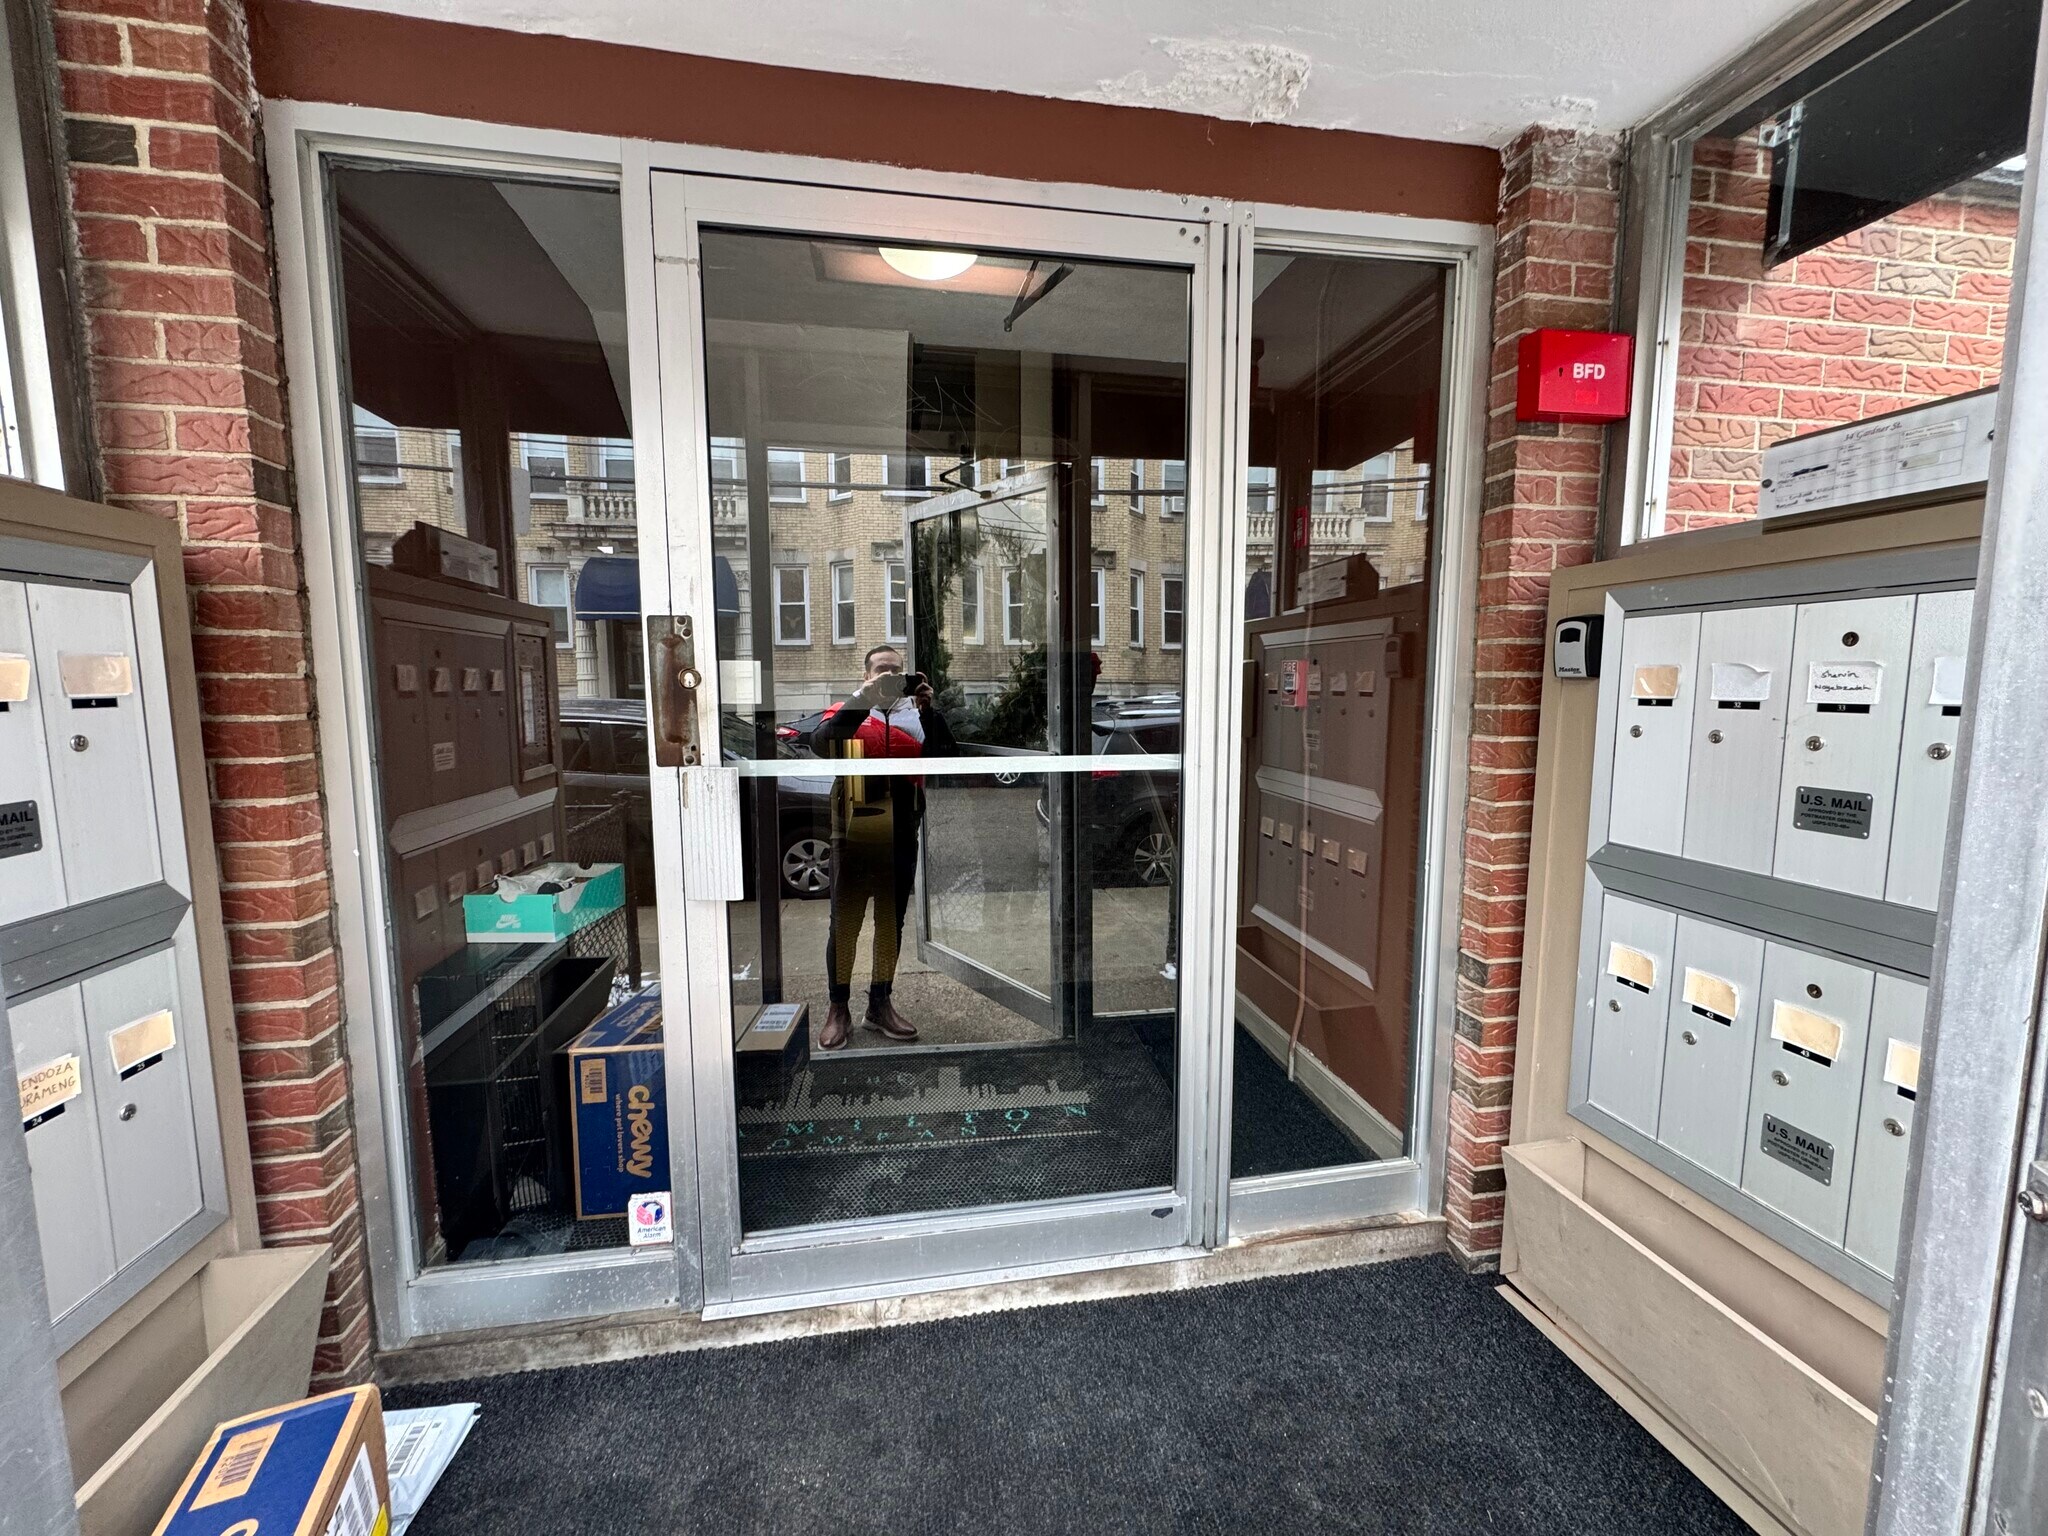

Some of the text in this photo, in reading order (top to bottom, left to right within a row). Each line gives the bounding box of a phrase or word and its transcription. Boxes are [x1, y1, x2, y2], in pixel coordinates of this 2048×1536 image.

[1573, 362, 1605, 379] BFD
[1283, 662, 1297, 673] FIRE
[1733, 701, 1742, 709] 32
[1836, 704, 1846, 712] 33
[1800, 794, 1868, 812] U.S. MAIL
[1801, 813, 1864, 826] POSTMASTER GENERAL
[1705, 1011, 1714, 1019] 42
[1800, 1049, 1810, 1058] 43
[20, 1062, 73, 1092] ENDOZA
[32, 1115, 43, 1127] 24
[614, 1093, 627, 1173] where pet lovers shop
[625, 1084, 656, 1179] chewy
[1767, 1121, 1829, 1160] U.S. MAIL
[637, 1226, 666, 1234] American
